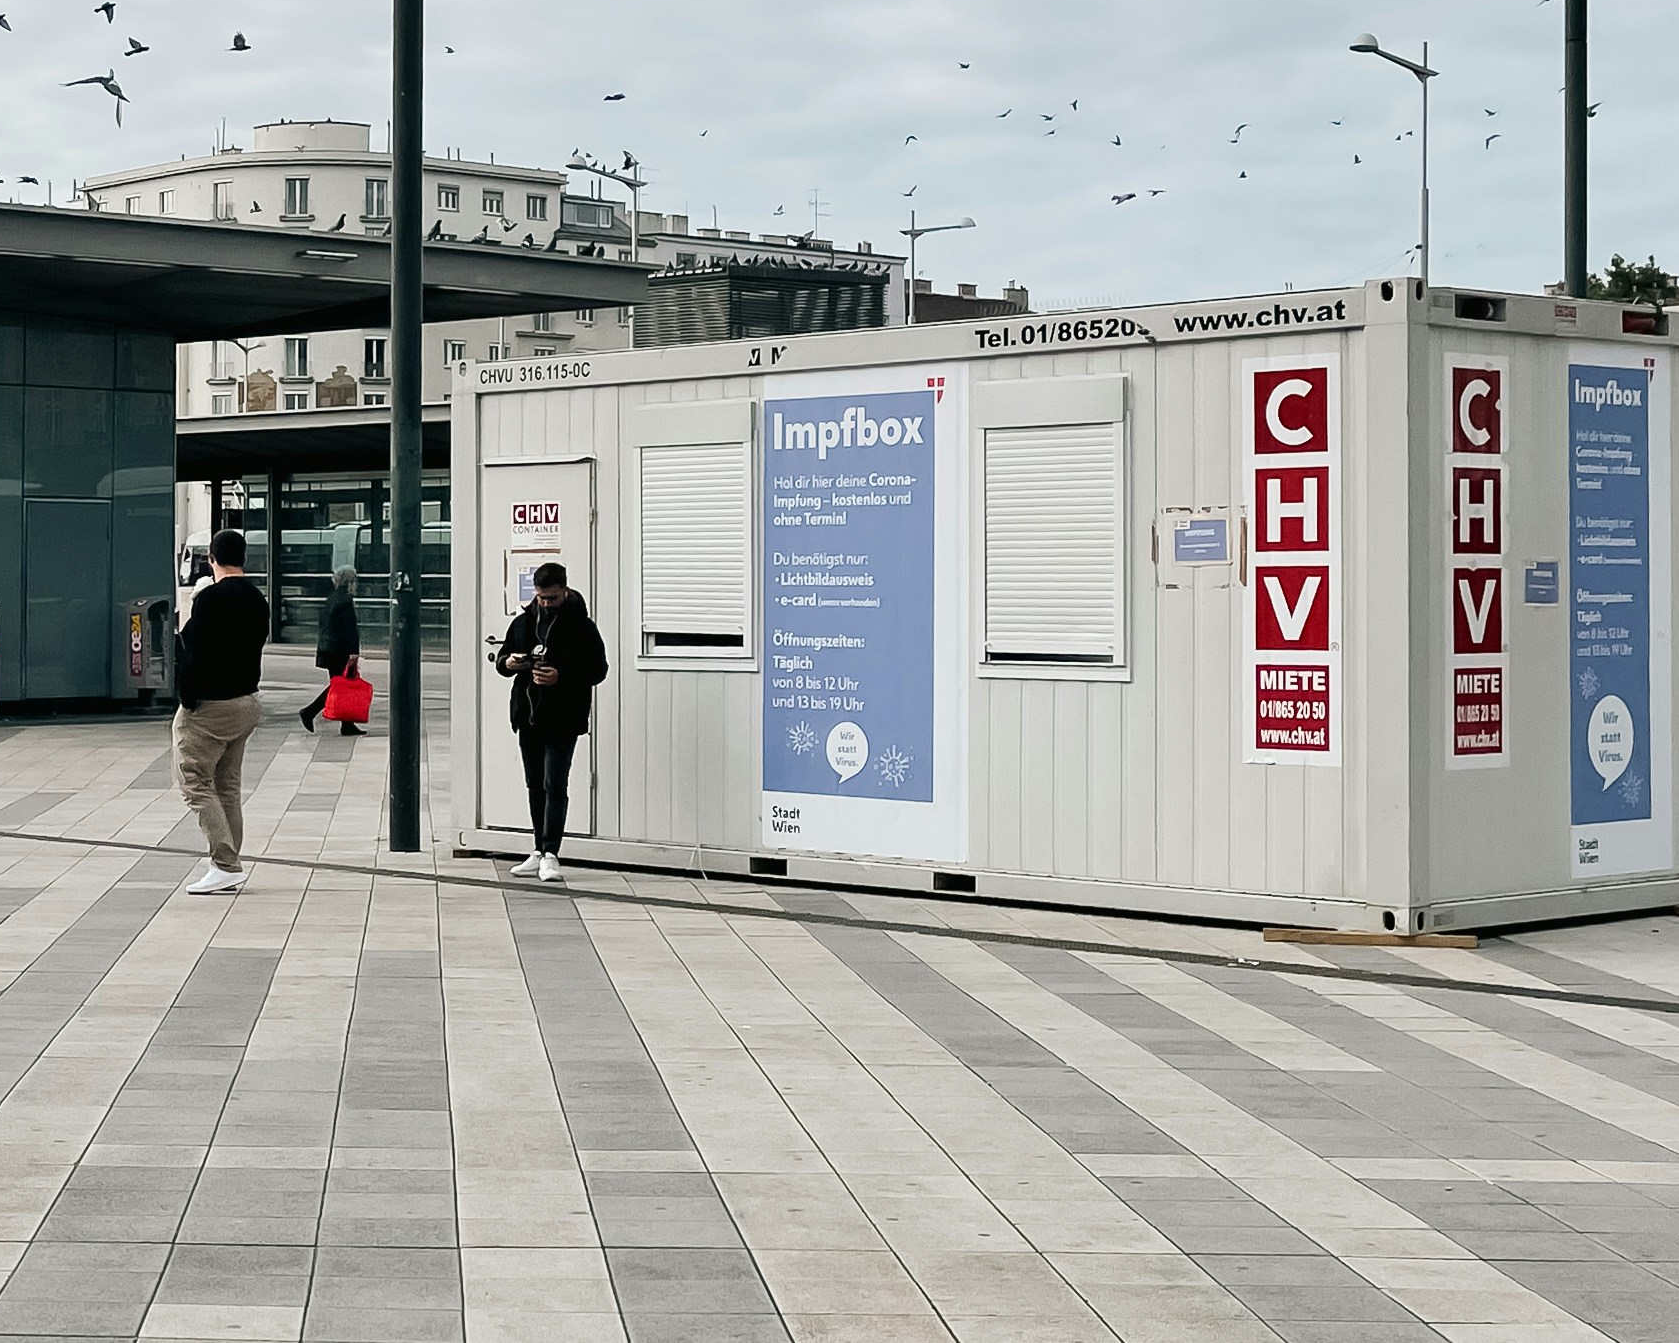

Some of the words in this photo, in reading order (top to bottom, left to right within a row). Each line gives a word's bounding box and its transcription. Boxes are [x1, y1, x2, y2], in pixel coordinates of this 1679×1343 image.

[975, 327, 1017, 349] Tel.
[1174, 299, 1346, 334] www.chv.at
[480, 367, 513, 384] CHVU
[1574, 378, 1642, 412] Impfbox
[774, 407, 924, 460] Impfbox
[774, 476, 794, 490] Hol
[795, 475, 811, 489] dir
[812, 474, 833, 489] hier
[835, 473, 867, 488] deine
[869, 472, 917, 487] Corona-
[773, 494, 822, 511] Impfung
[832, 491, 887, 507] kostenlos
[889, 491, 912, 506] und
[1263, 378, 1322, 641] CHV
[514, 505, 558, 523] CHV
[773, 512, 802, 526] ohne
[804, 511, 847, 526] Termin!
[1458, 378, 1497, 644] CHV
[512, 525, 559, 535] CONTAINER
[773, 552, 790, 566] Du
[792, 552, 844, 569] benötigst
[846, 554, 869, 566] nur:
[780, 572, 874, 587] Lichtbildausweis
[780, 593, 817, 607] e-card
[773, 629, 866, 651] Öffnungszeiten:
[773, 655, 814, 673] Täglich
[772, 677, 794, 689] von
[795, 675, 804, 690] 8
[806, 675, 822, 690] bis
[824, 676, 836, 691] 12
[838, 676, 860, 691] Uhr
[1259, 670, 1327, 692] MIETE
[1456, 673, 1500, 695] MIETE
[772, 694, 795, 708] und
[796, 695, 809, 709] 13
[810, 695, 826, 710] bis
[829, 696, 842, 710] 19
[843, 697, 865, 712] Uhr
[1259, 700, 1294, 719] 01/865
[1296, 701, 1311, 720] 20
[1312, 701, 1326, 720] 50
[1602, 711, 1619, 725] Wir
[839, 730, 855, 741] Wir
[1260, 726, 1326, 746] www.chv.at
[772, 805, 801, 819] Stadt
[772, 819, 801, 834] Wien
